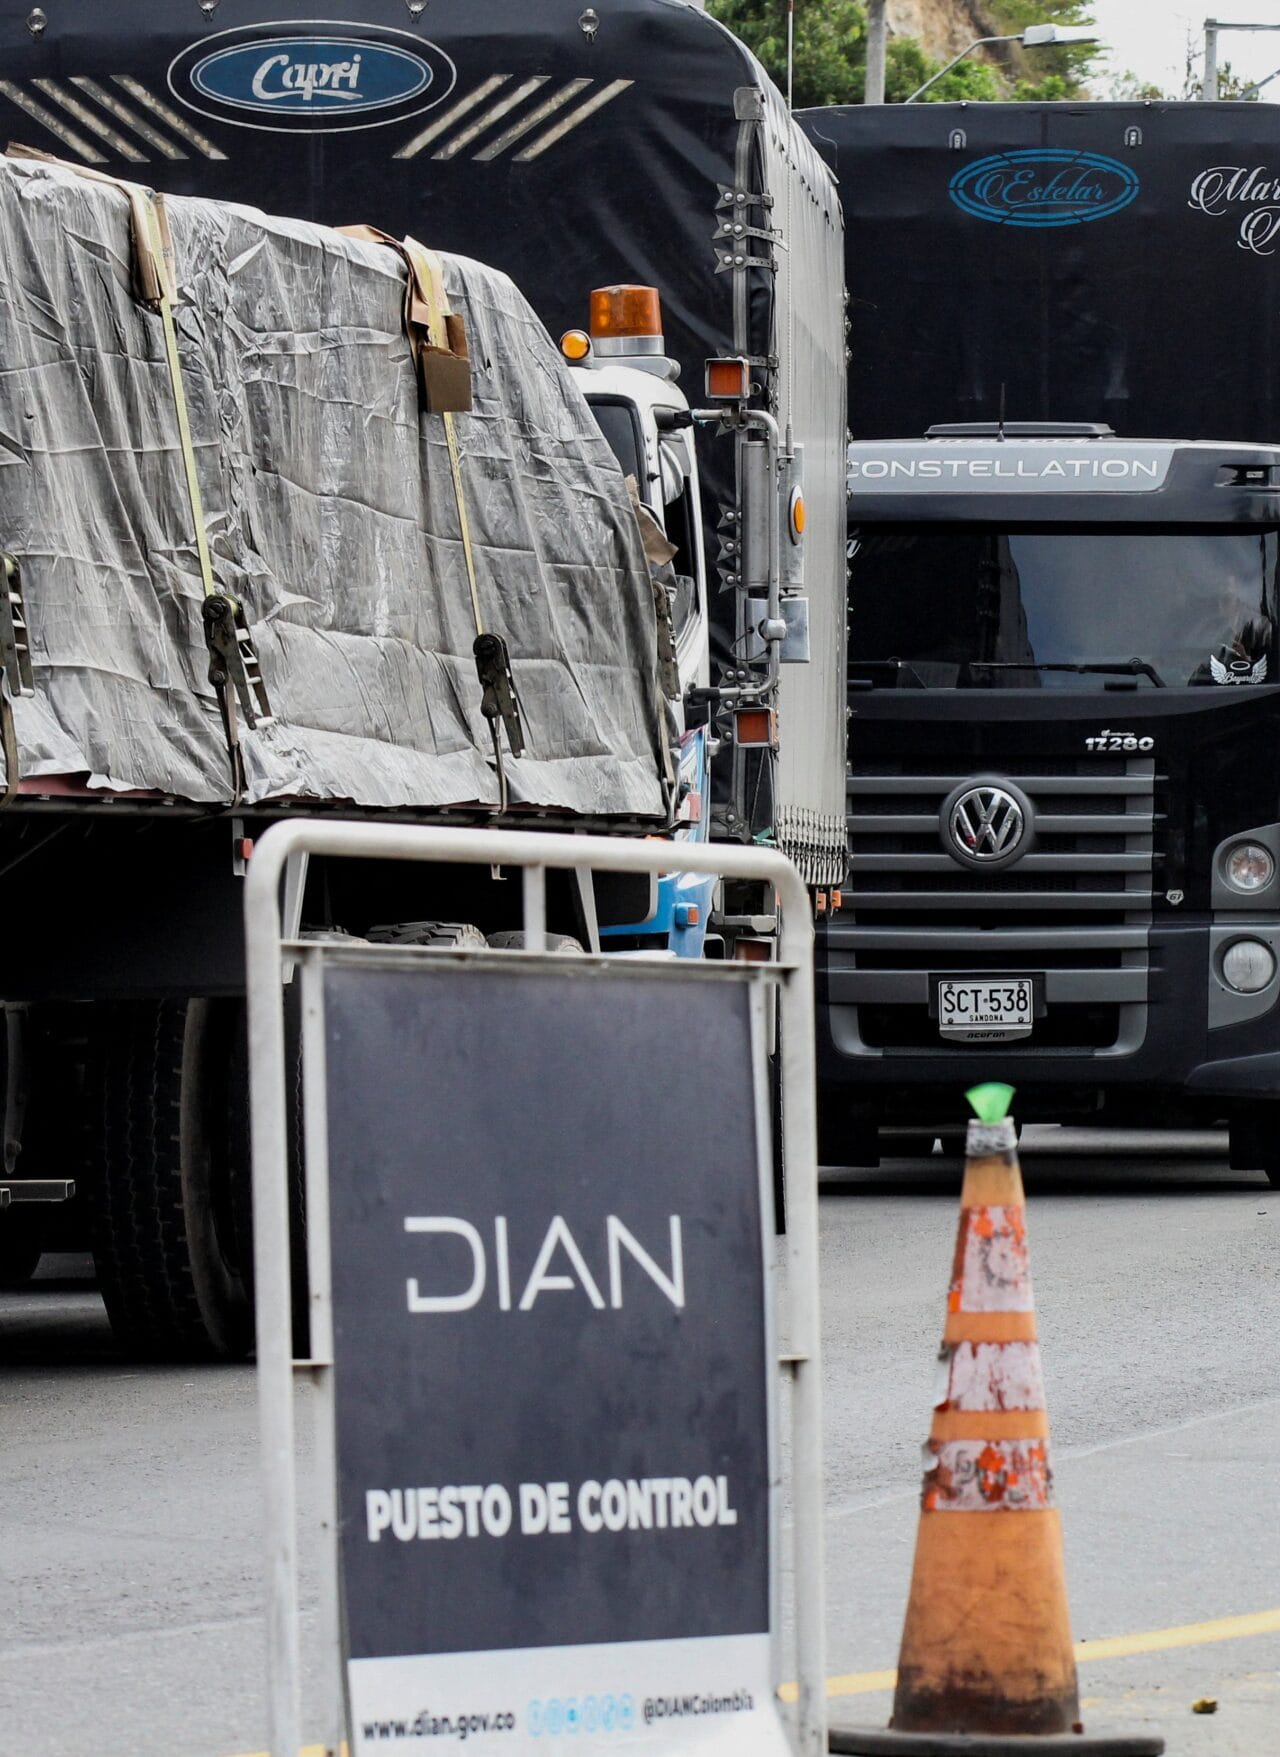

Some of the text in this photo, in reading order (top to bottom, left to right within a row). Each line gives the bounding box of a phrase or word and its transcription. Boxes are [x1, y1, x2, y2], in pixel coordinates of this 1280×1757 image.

[252, 53, 364, 101] Capri
[974, 166, 1109, 210] Estelar
[404, 1214, 685, 1313] DIAN
[366, 1474, 738, 1543] PUESTO DE CONTROL
[362, 1709, 516, 1740] www.dian.gov.co
